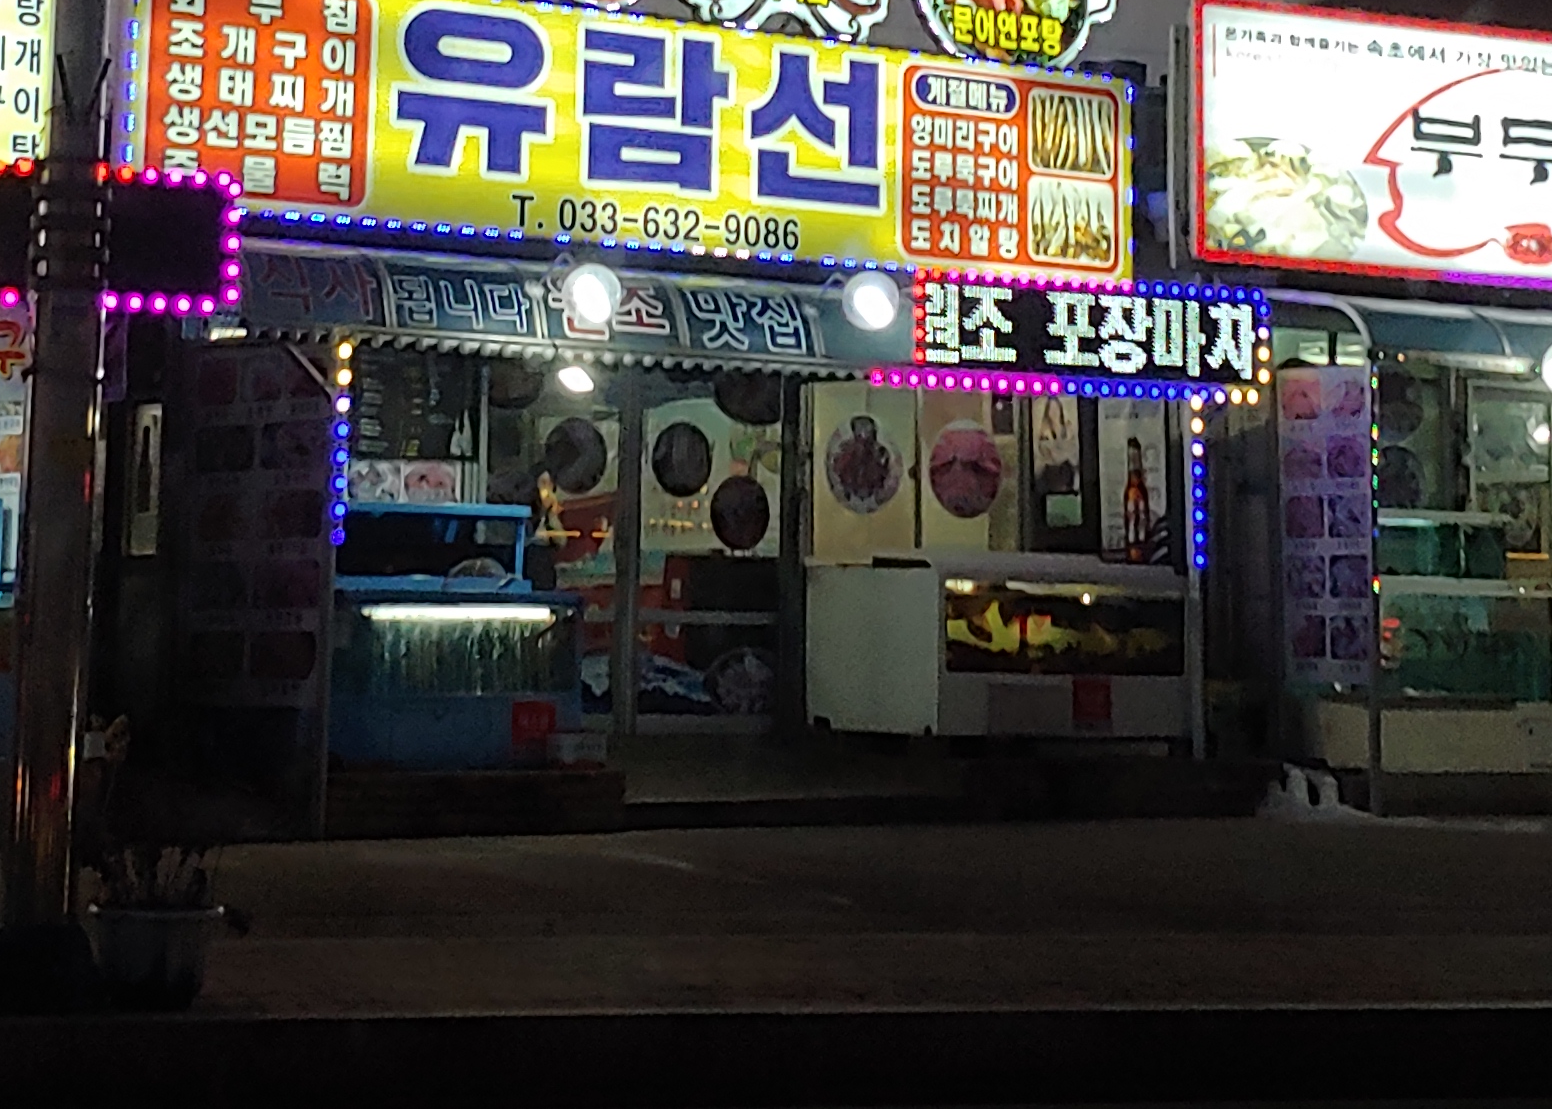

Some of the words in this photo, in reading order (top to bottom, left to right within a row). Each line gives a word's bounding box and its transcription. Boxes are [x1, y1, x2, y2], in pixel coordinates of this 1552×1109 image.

[168, 19, 355, 75] 조개구이
[953, 4, 1063, 55] 문어연포탕
[1367, 40, 1446, 63] 속초에서
[165, 62, 354, 117] 생태찌개
[397, 7, 882, 209] 유람선
[927, 76, 1008, 113] 계절메뉴
[164, 104, 352, 159] 생선모듬찜
[911, 114, 1018, 156] 양미리구이
[911, 149, 1018, 190] 도루묵구이
[559, 199, 799, 250] 033-632-9086
[911, 184, 1018, 225] 도루묵찌개
[911, 219, 1019, 259] 도치알탕
[686, 291, 806, 355] 맛집
